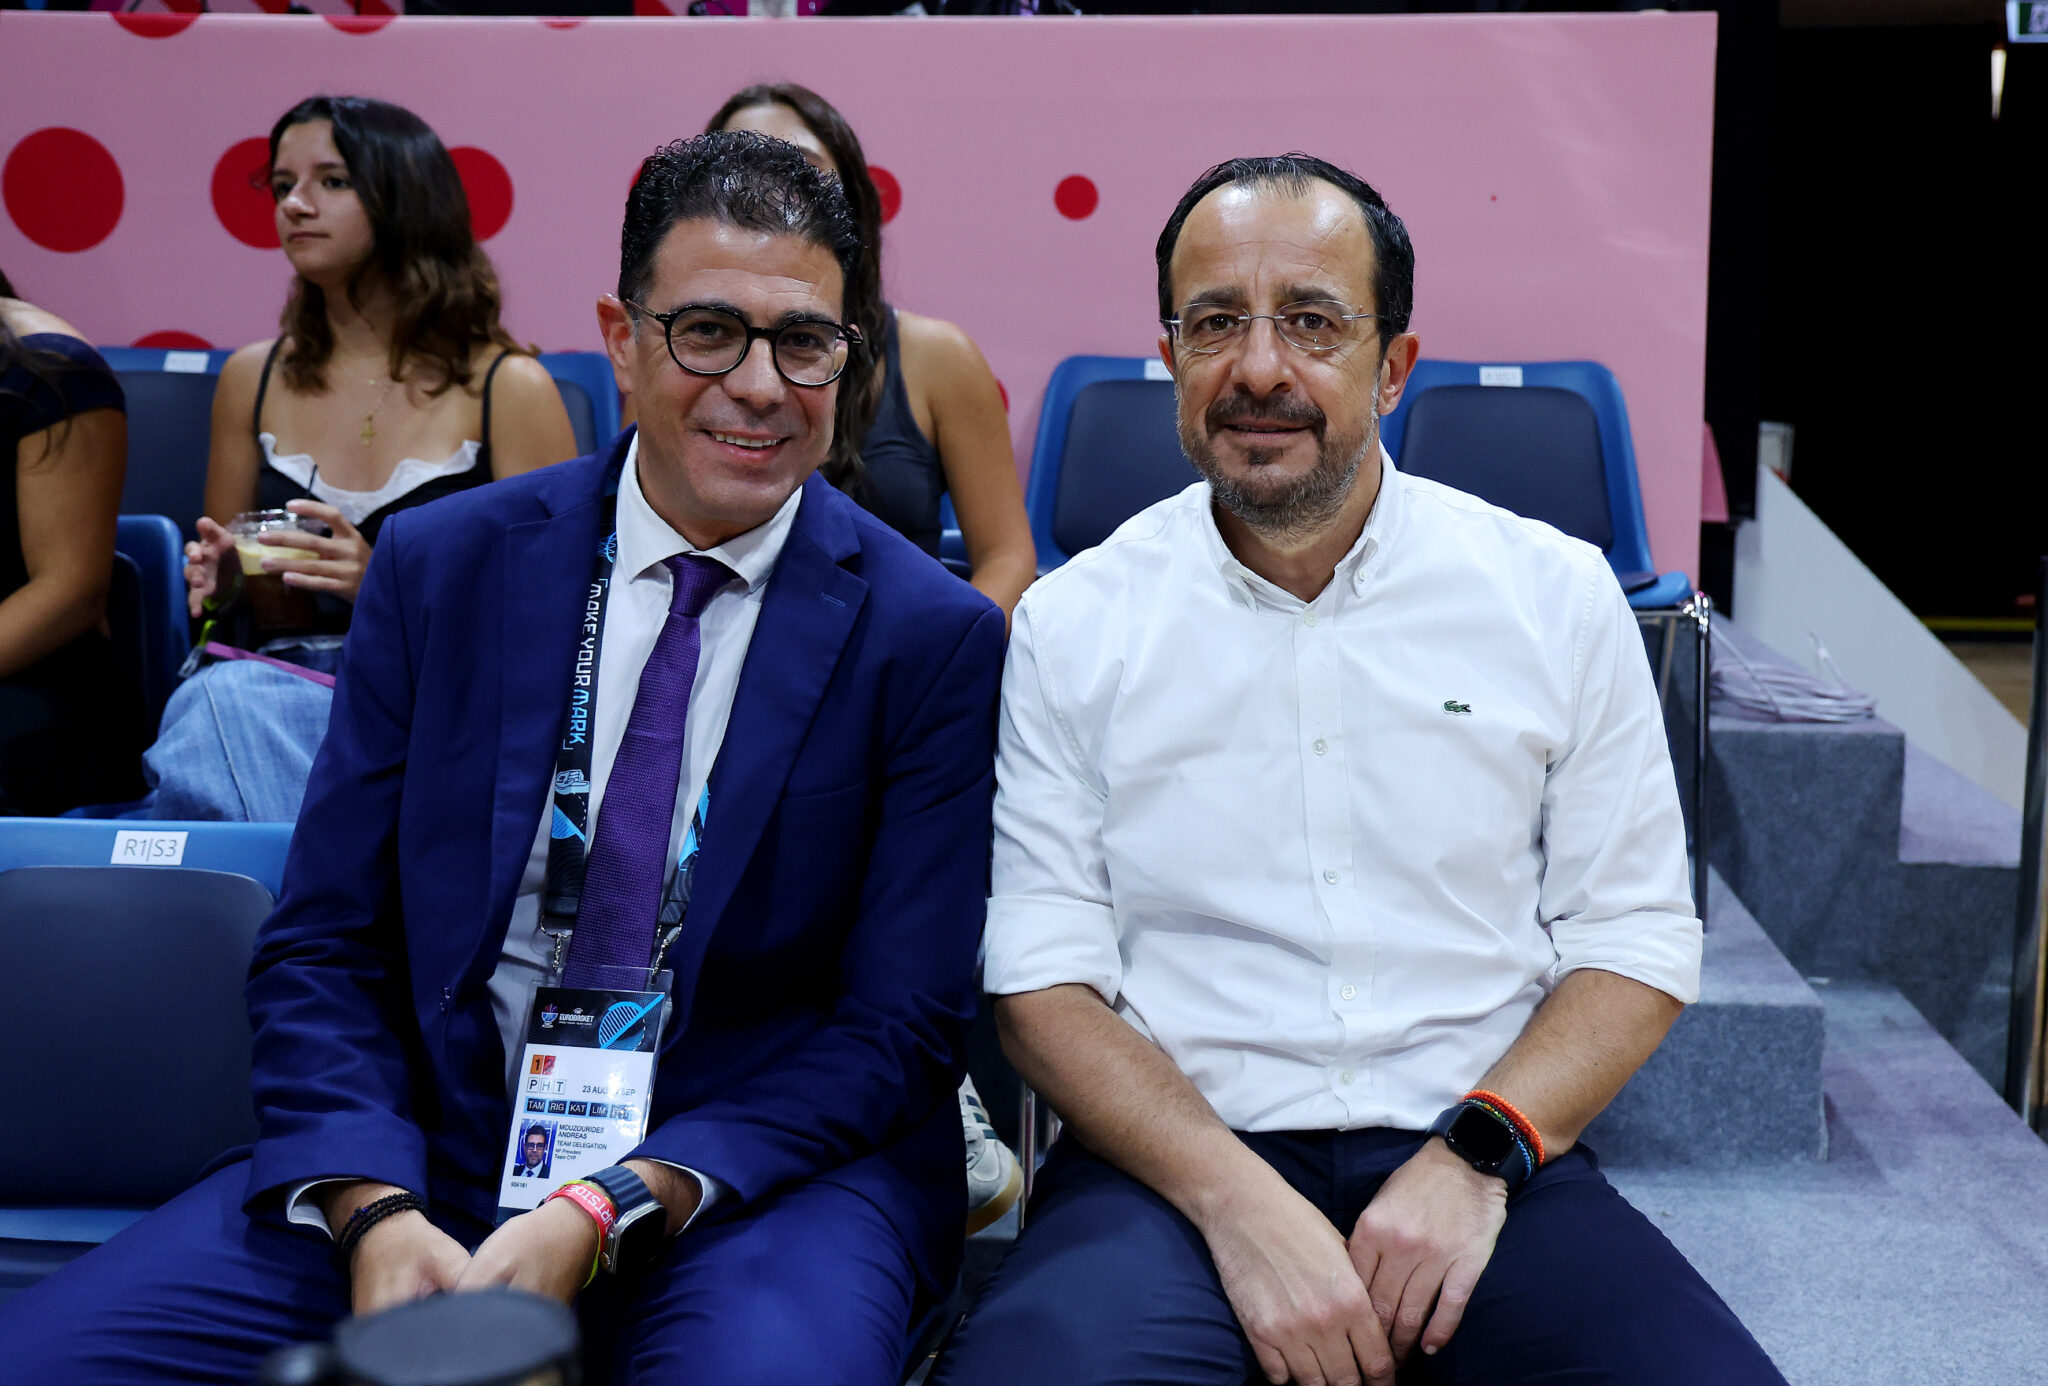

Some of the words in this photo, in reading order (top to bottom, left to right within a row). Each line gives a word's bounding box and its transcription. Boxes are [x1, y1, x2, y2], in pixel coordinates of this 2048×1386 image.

[582, 583, 602, 635] MAKE
[574, 637, 595, 687] YOUR
[568, 689, 590, 744] MARK
[529, 1079, 538, 1090] P
[541, 1080, 551, 1091] H
[556, 1081, 564, 1092] T
[582, 1085, 591, 1093] 23
[592, 1085, 608, 1095] AUG
[528, 1100, 545, 1110] TAM
[550, 1102, 564, 1111] RIG
[569, 1103, 586, 1113] KAT
[591, 1105, 607, 1115] LIM
[558, 1131, 588, 1140] ANDREAS
[559, 1124, 605, 1134] MOUZOURIDES
[573, 1141, 607, 1150] DELEGATION
